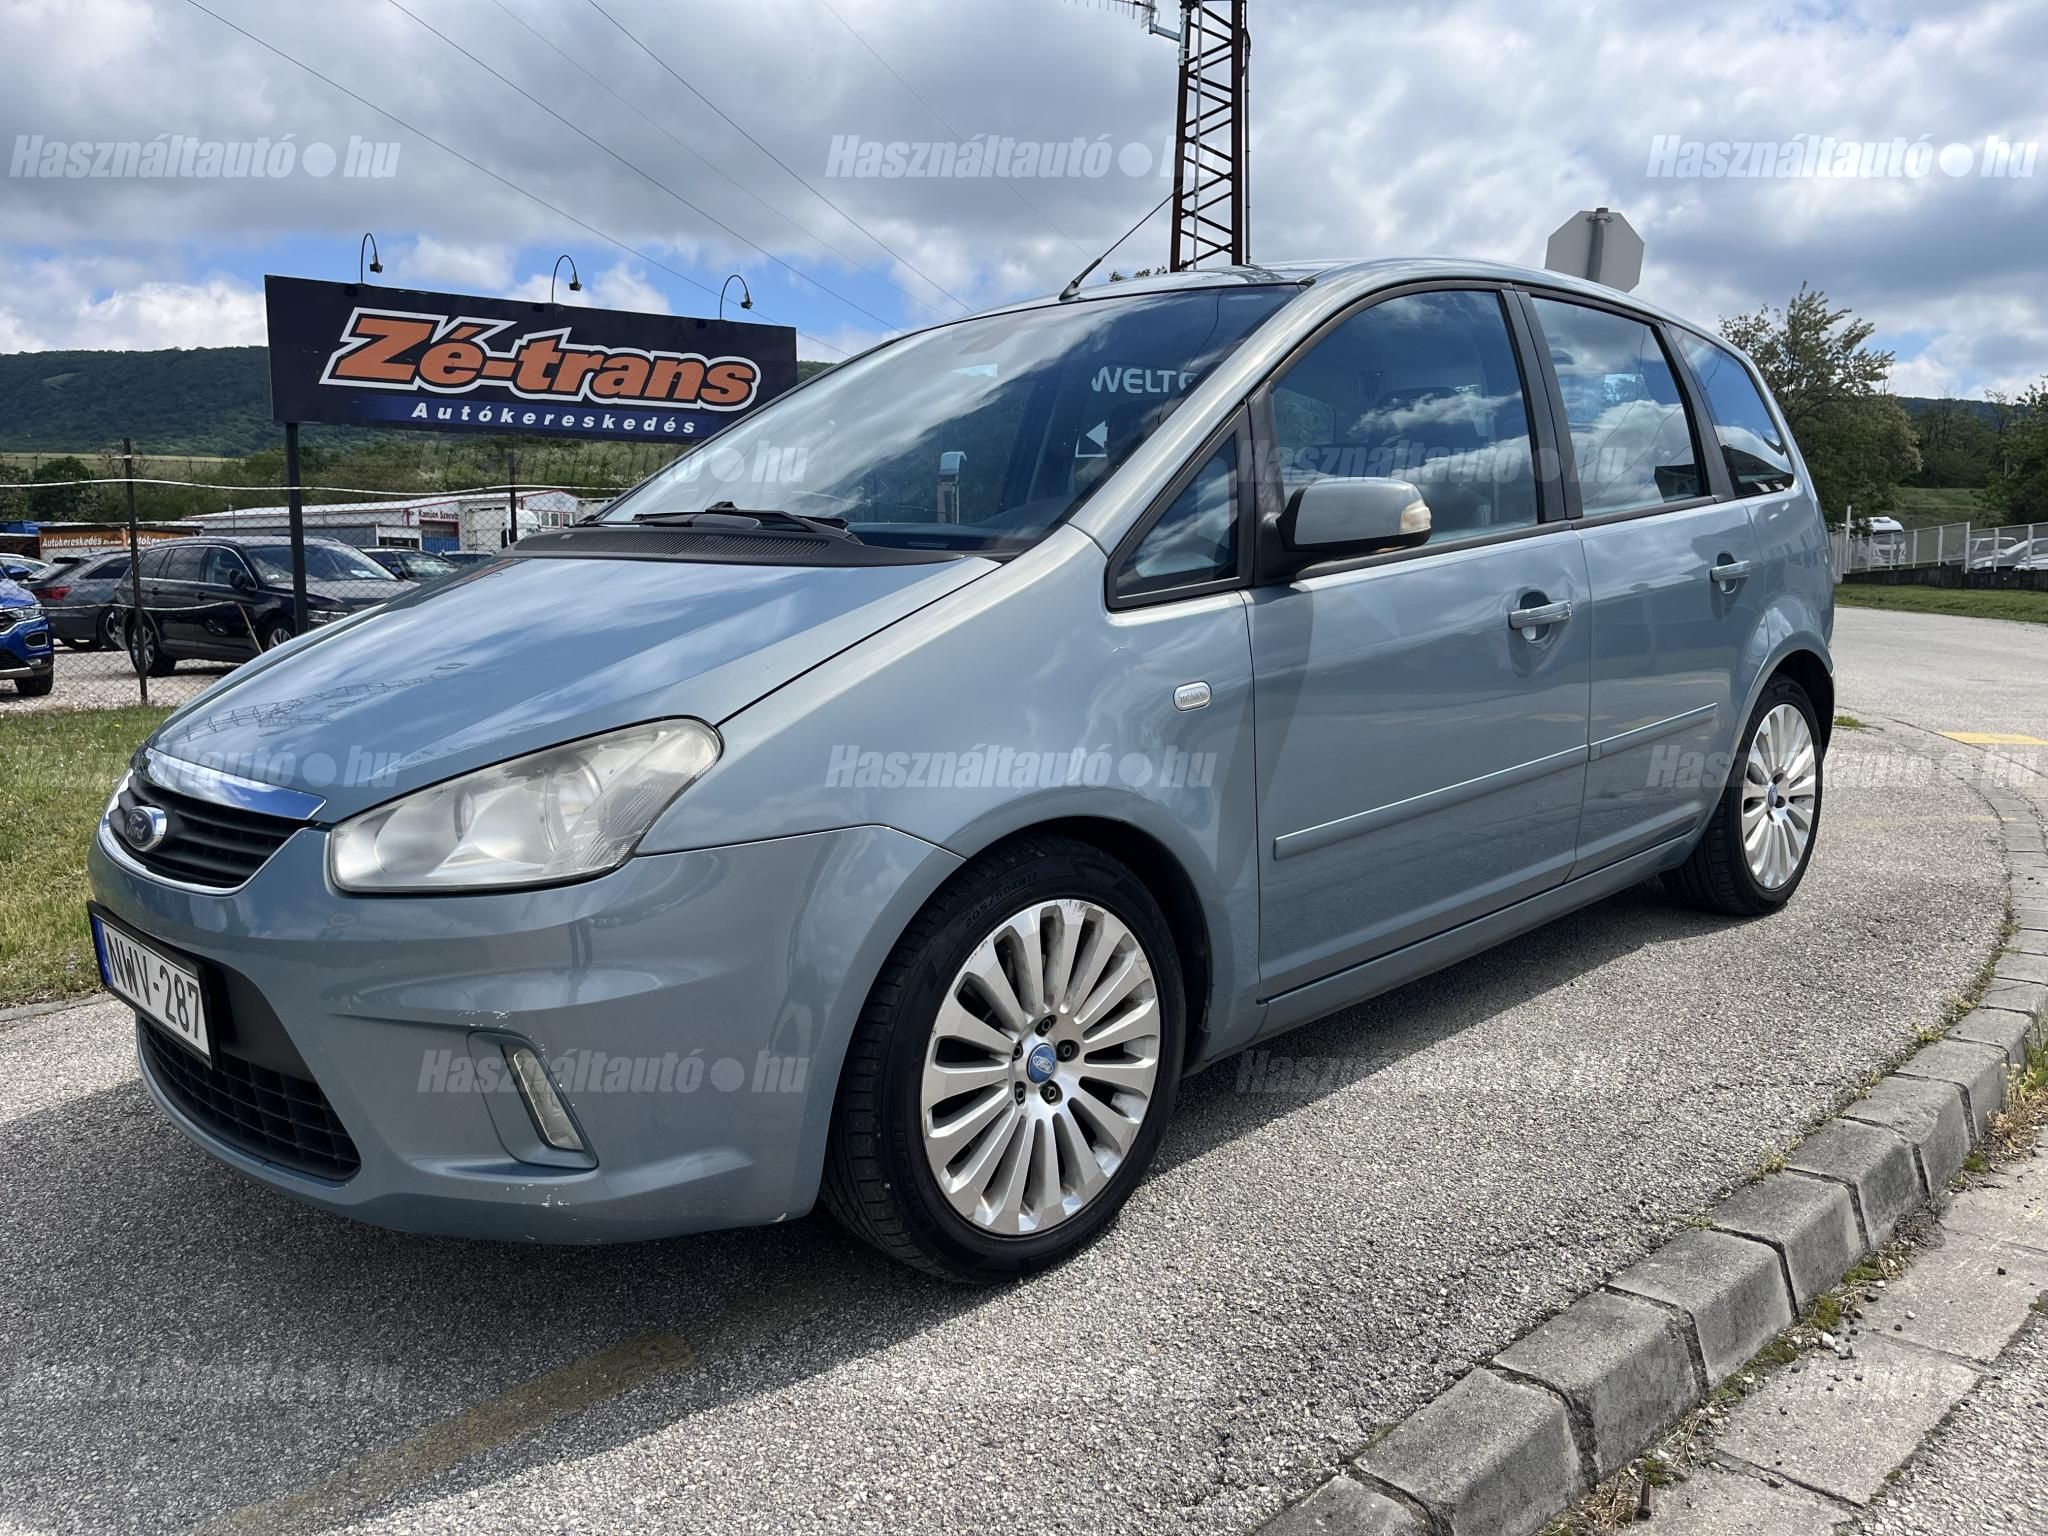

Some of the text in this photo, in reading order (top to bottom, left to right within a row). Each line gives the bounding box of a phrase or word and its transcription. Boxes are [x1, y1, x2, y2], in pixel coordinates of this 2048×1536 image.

[322, 309, 760, 409] Zé-trans
[411, 402, 696, 435] Autókereskedés
[106, 931, 199, 1040] NWV-287
